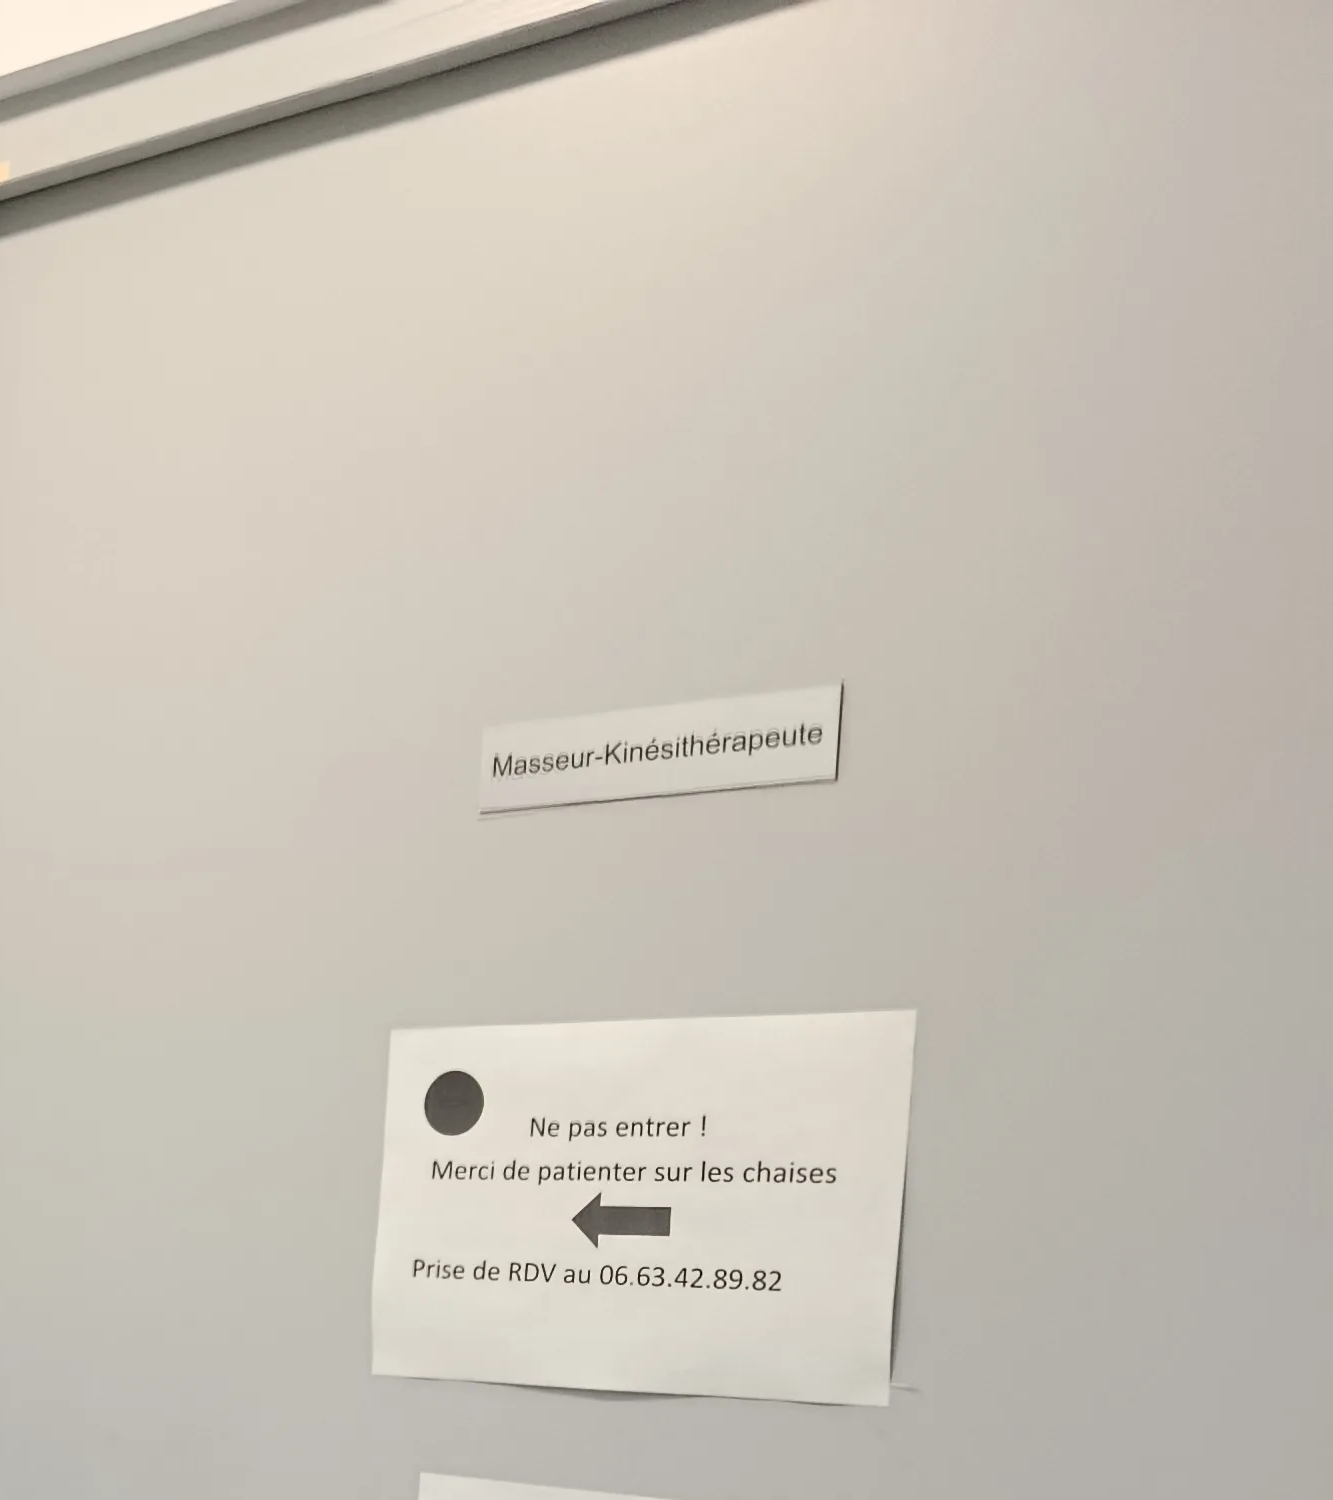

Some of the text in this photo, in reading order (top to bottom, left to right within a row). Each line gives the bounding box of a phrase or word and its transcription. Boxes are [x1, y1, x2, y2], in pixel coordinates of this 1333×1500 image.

[492, 723, 823, 779] Masseur-Kinésithérapeute
[530, 1115, 708, 1142] Ne pas entrer !
[432, 1160, 838, 1185] Merci de patienter sur les chaises
[412, 1259, 783, 1292] Prise de RDV au 06.63.42.89.82
